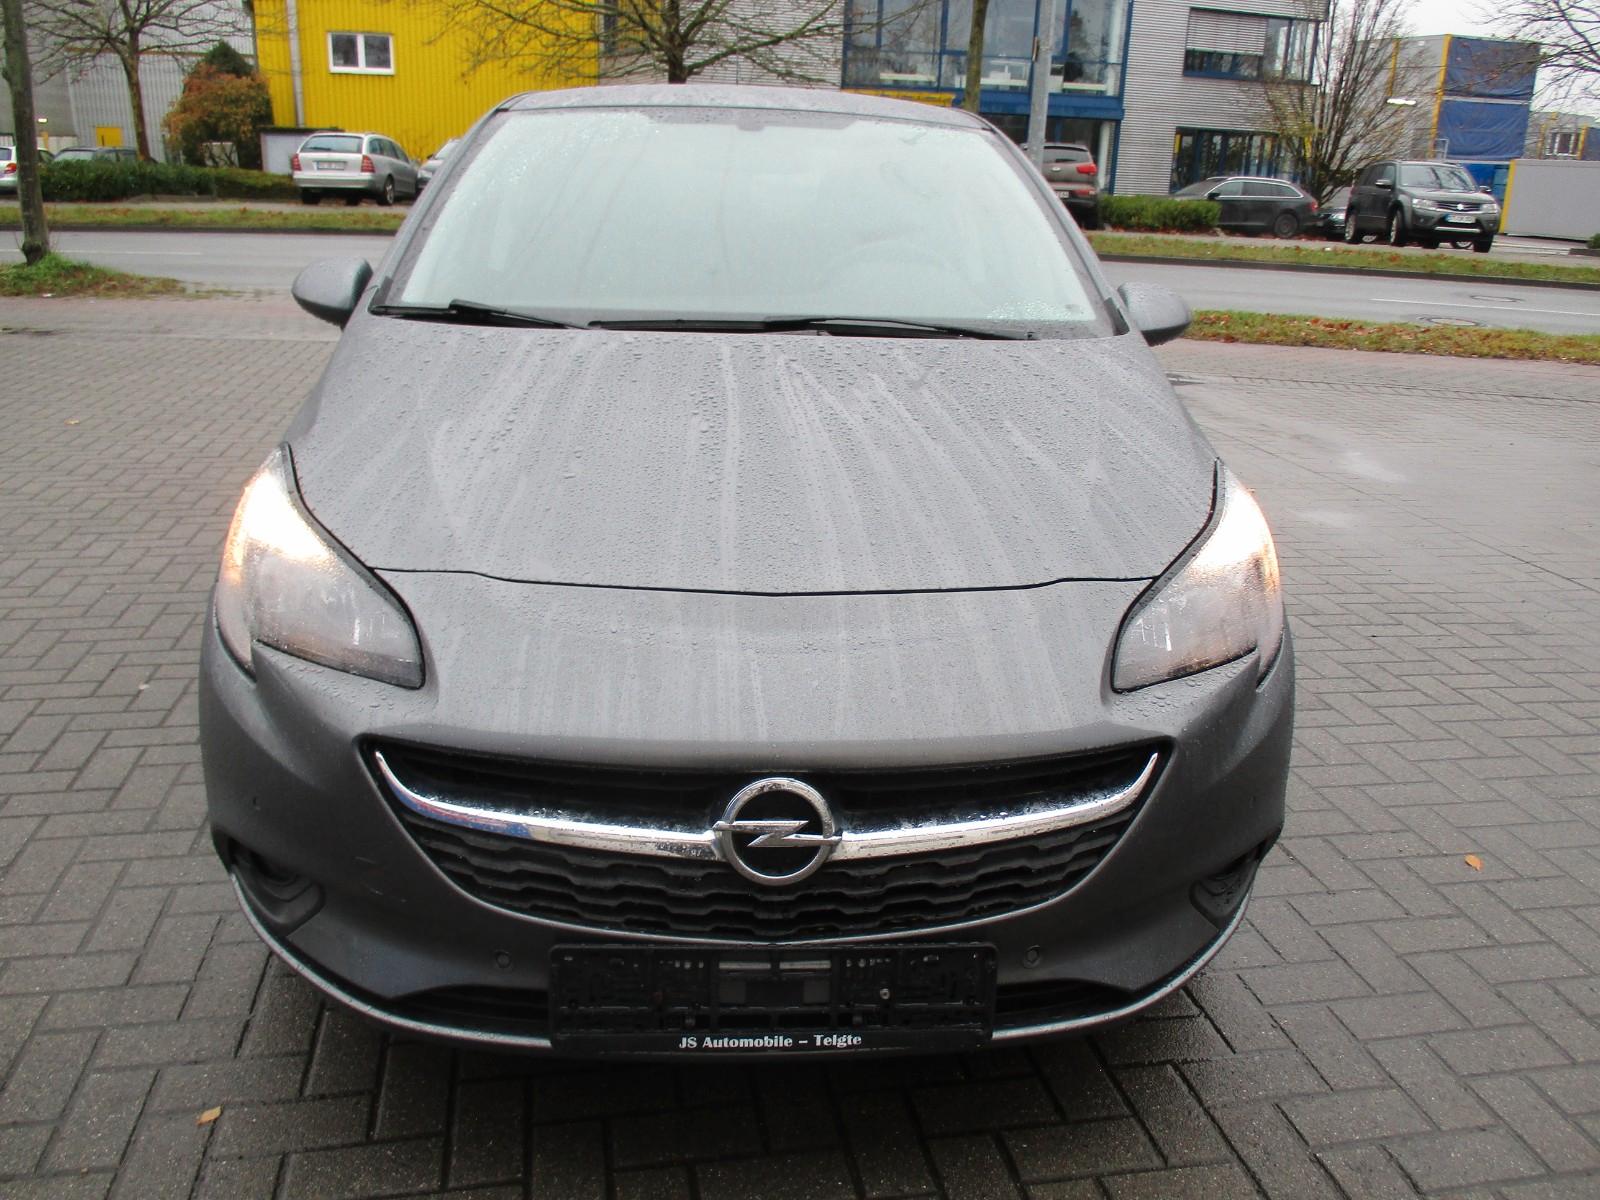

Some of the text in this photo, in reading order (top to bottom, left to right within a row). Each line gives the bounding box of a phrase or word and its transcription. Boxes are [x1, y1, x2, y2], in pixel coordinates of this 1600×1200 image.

[679, 1036, 698, 1049] JS
[702, 1035, 793, 1048] Automobile
[813, 1034, 862, 1048] Telgte
